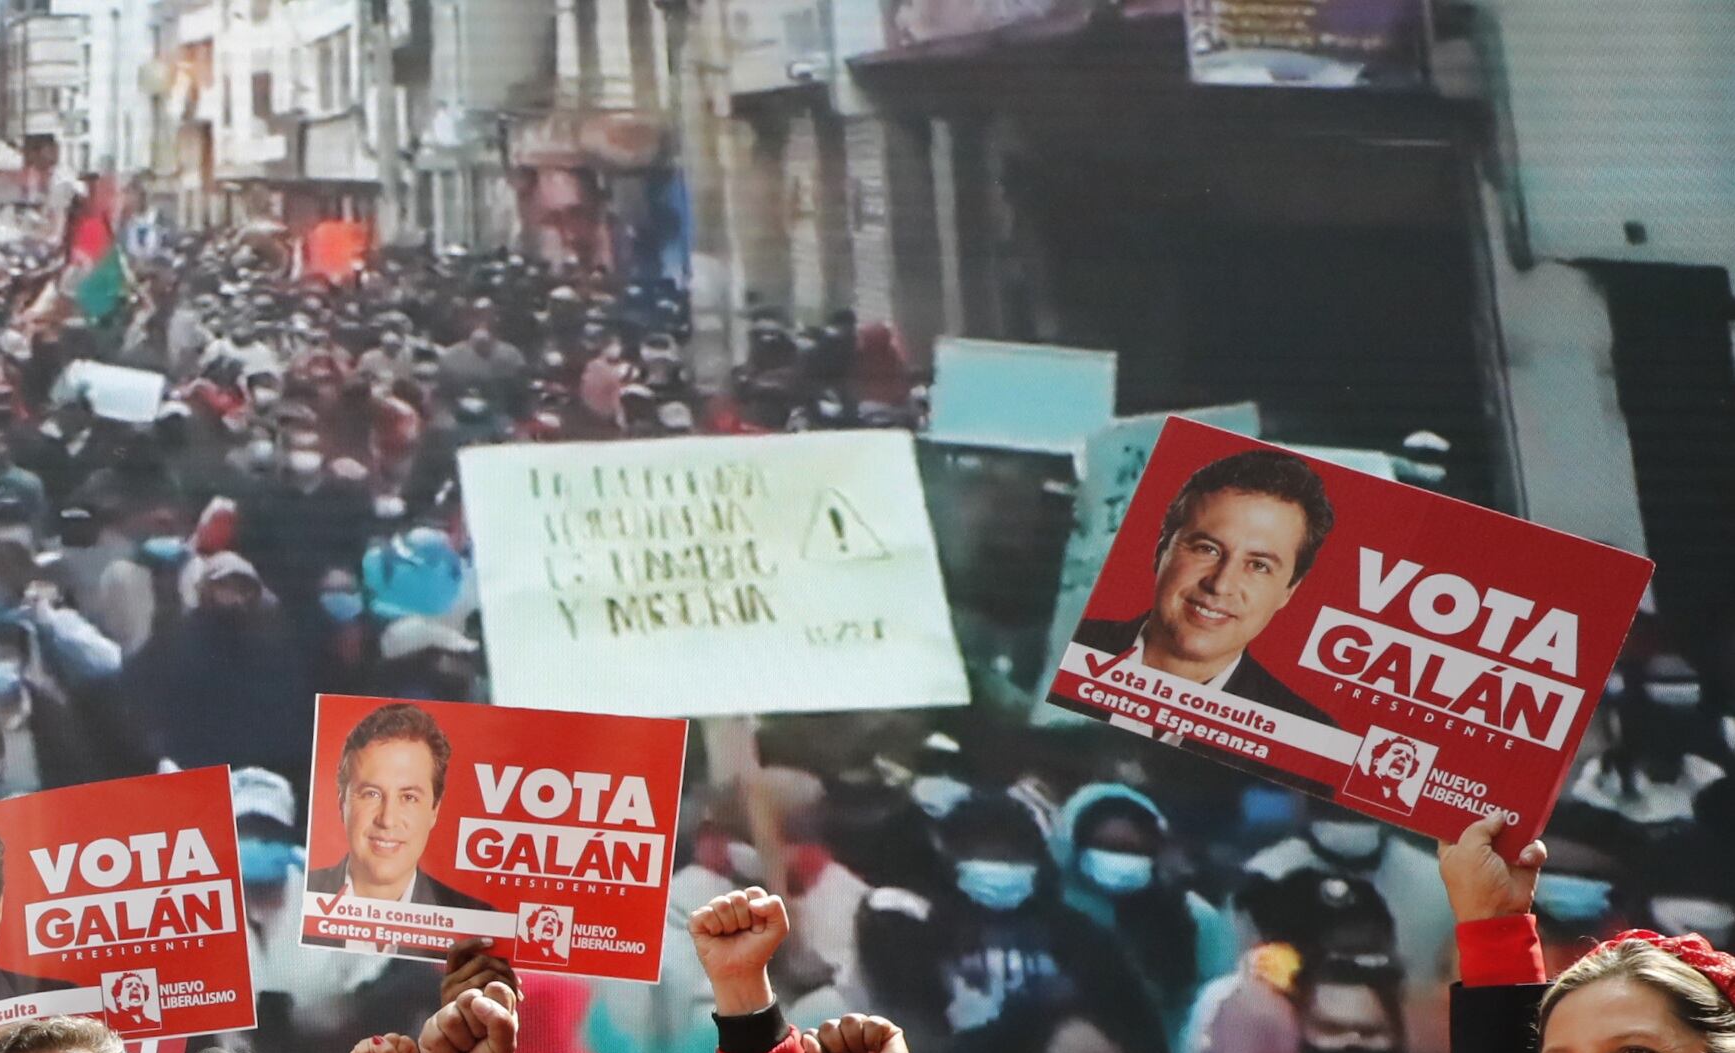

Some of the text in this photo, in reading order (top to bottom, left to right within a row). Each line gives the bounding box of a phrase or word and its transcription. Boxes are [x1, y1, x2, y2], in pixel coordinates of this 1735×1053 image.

[1359, 546, 1580, 677] VOTA
[1316, 623, 1563, 742] GALÁN
[1077, 682, 1269, 758] Centro Esperanza
[1152, 678, 1172, 699] la
[1178, 693, 1276, 733] consulta
[1333, 682, 1514, 750] PRESIDENTE
[473, 763, 656, 827] VOTA
[1429, 768, 1487, 797] NUEVO
[29, 828, 220, 895] VOTA
[465, 828, 650, 883] GALÁN
[486, 875, 626, 896] PRESIDENTE
[35, 888, 223, 949] GALÁN
[318, 920, 371, 938] Centro
[368, 905, 380, 919] la
[386, 912, 454, 928] consulta
[573, 924, 617, 938] NUEVO
[61, 938, 205, 962] PRESIDENTE
[571, 937, 646, 955] LIBERALISMO
[160, 980, 205, 994] NUEVO
[160, 990, 236, 1009] LIBERALISMO
